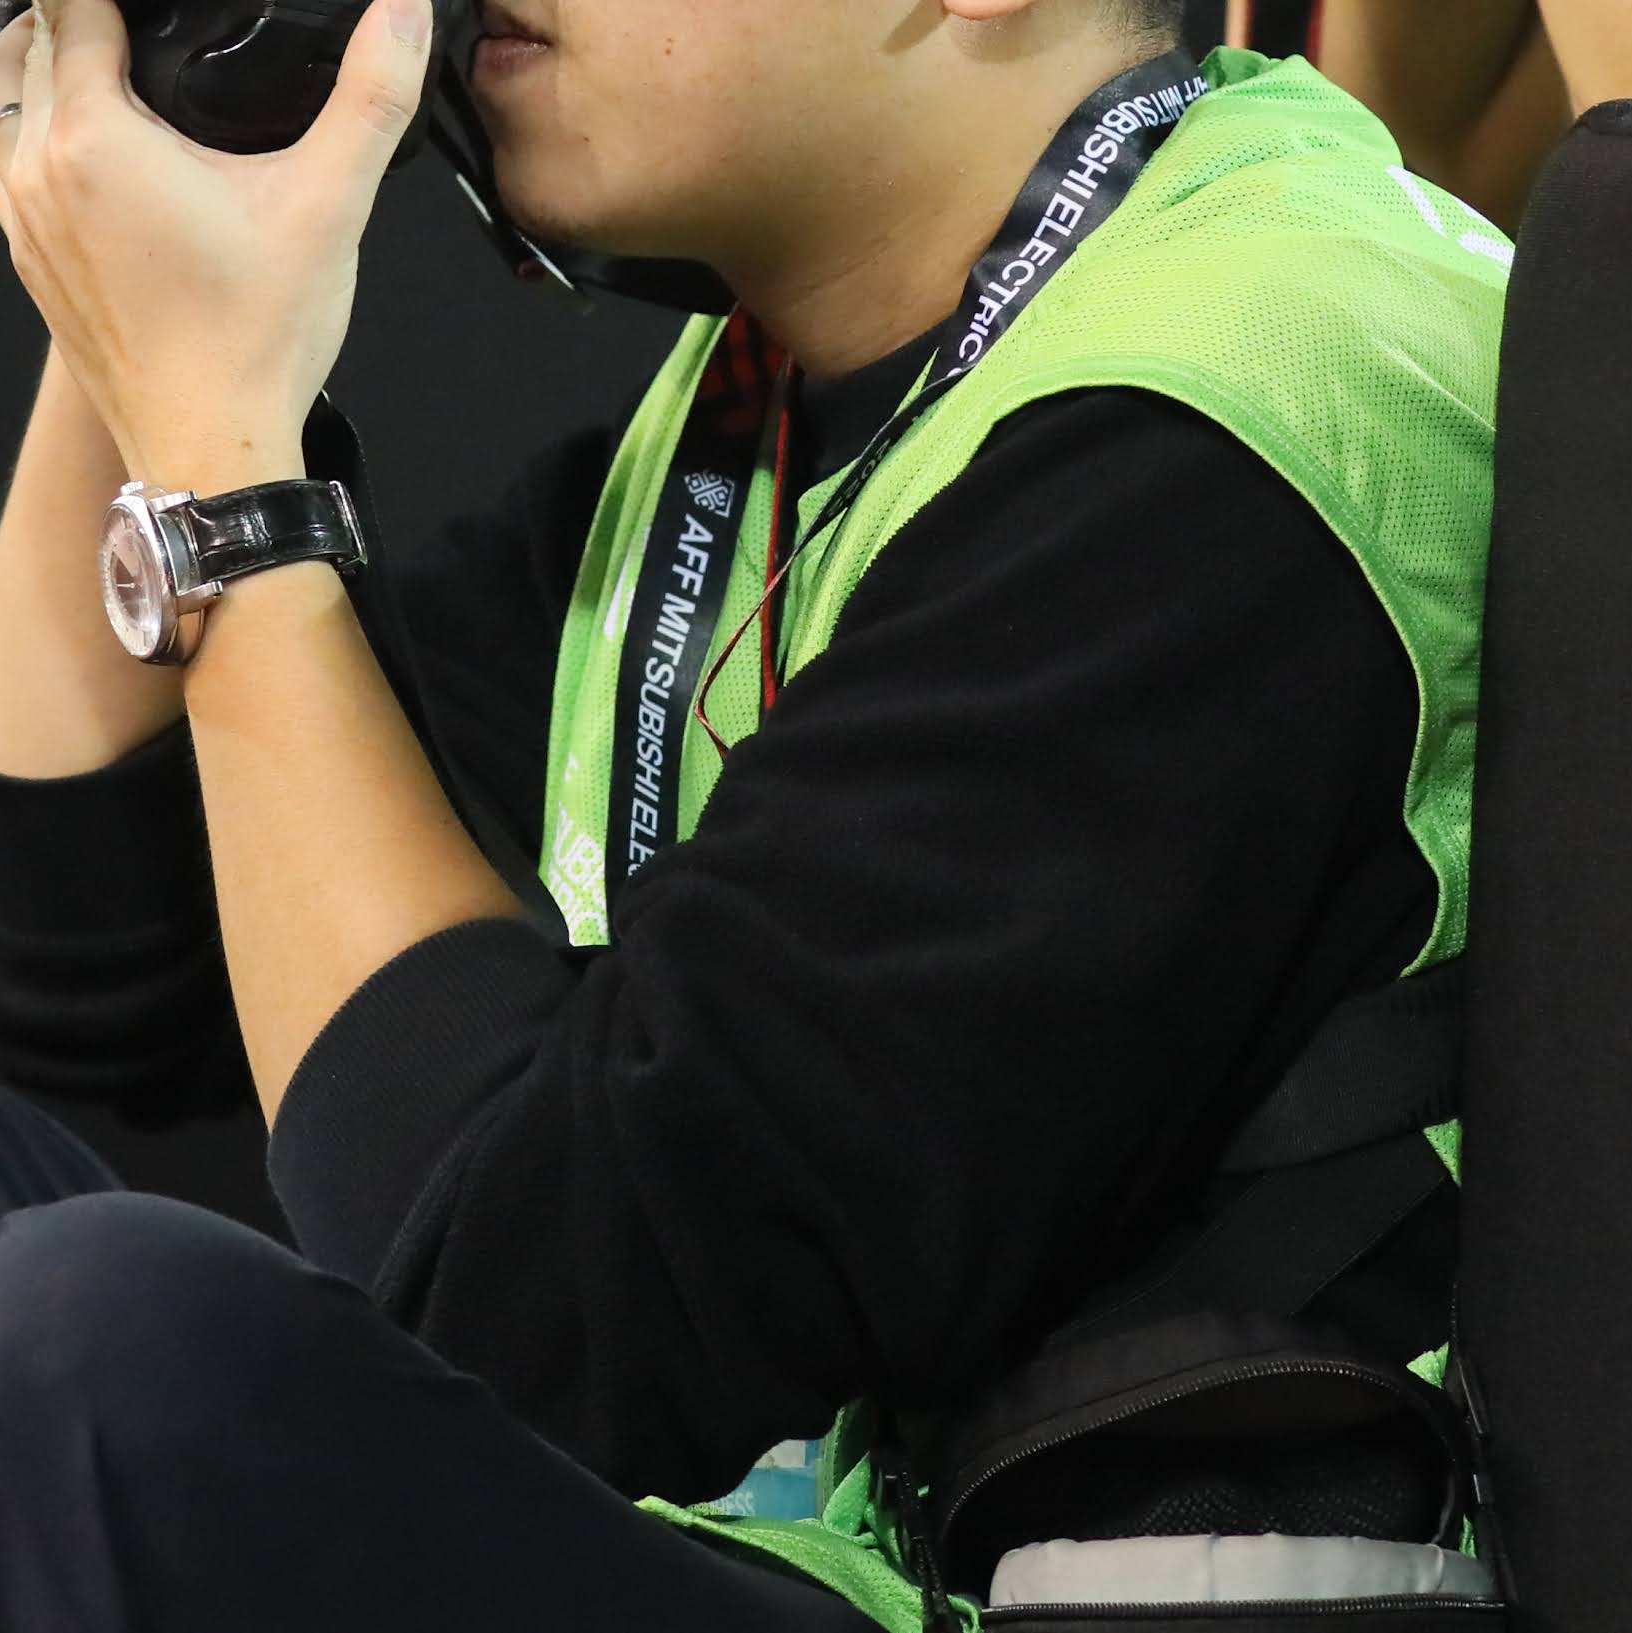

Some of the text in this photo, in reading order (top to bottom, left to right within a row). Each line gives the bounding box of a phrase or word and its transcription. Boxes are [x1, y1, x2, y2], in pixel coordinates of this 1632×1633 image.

[958, 192, 1086, 363] ELECTRIC
[671, 512, 714, 597] AFF
[633, 591, 697, 803] MITSUBISHI
